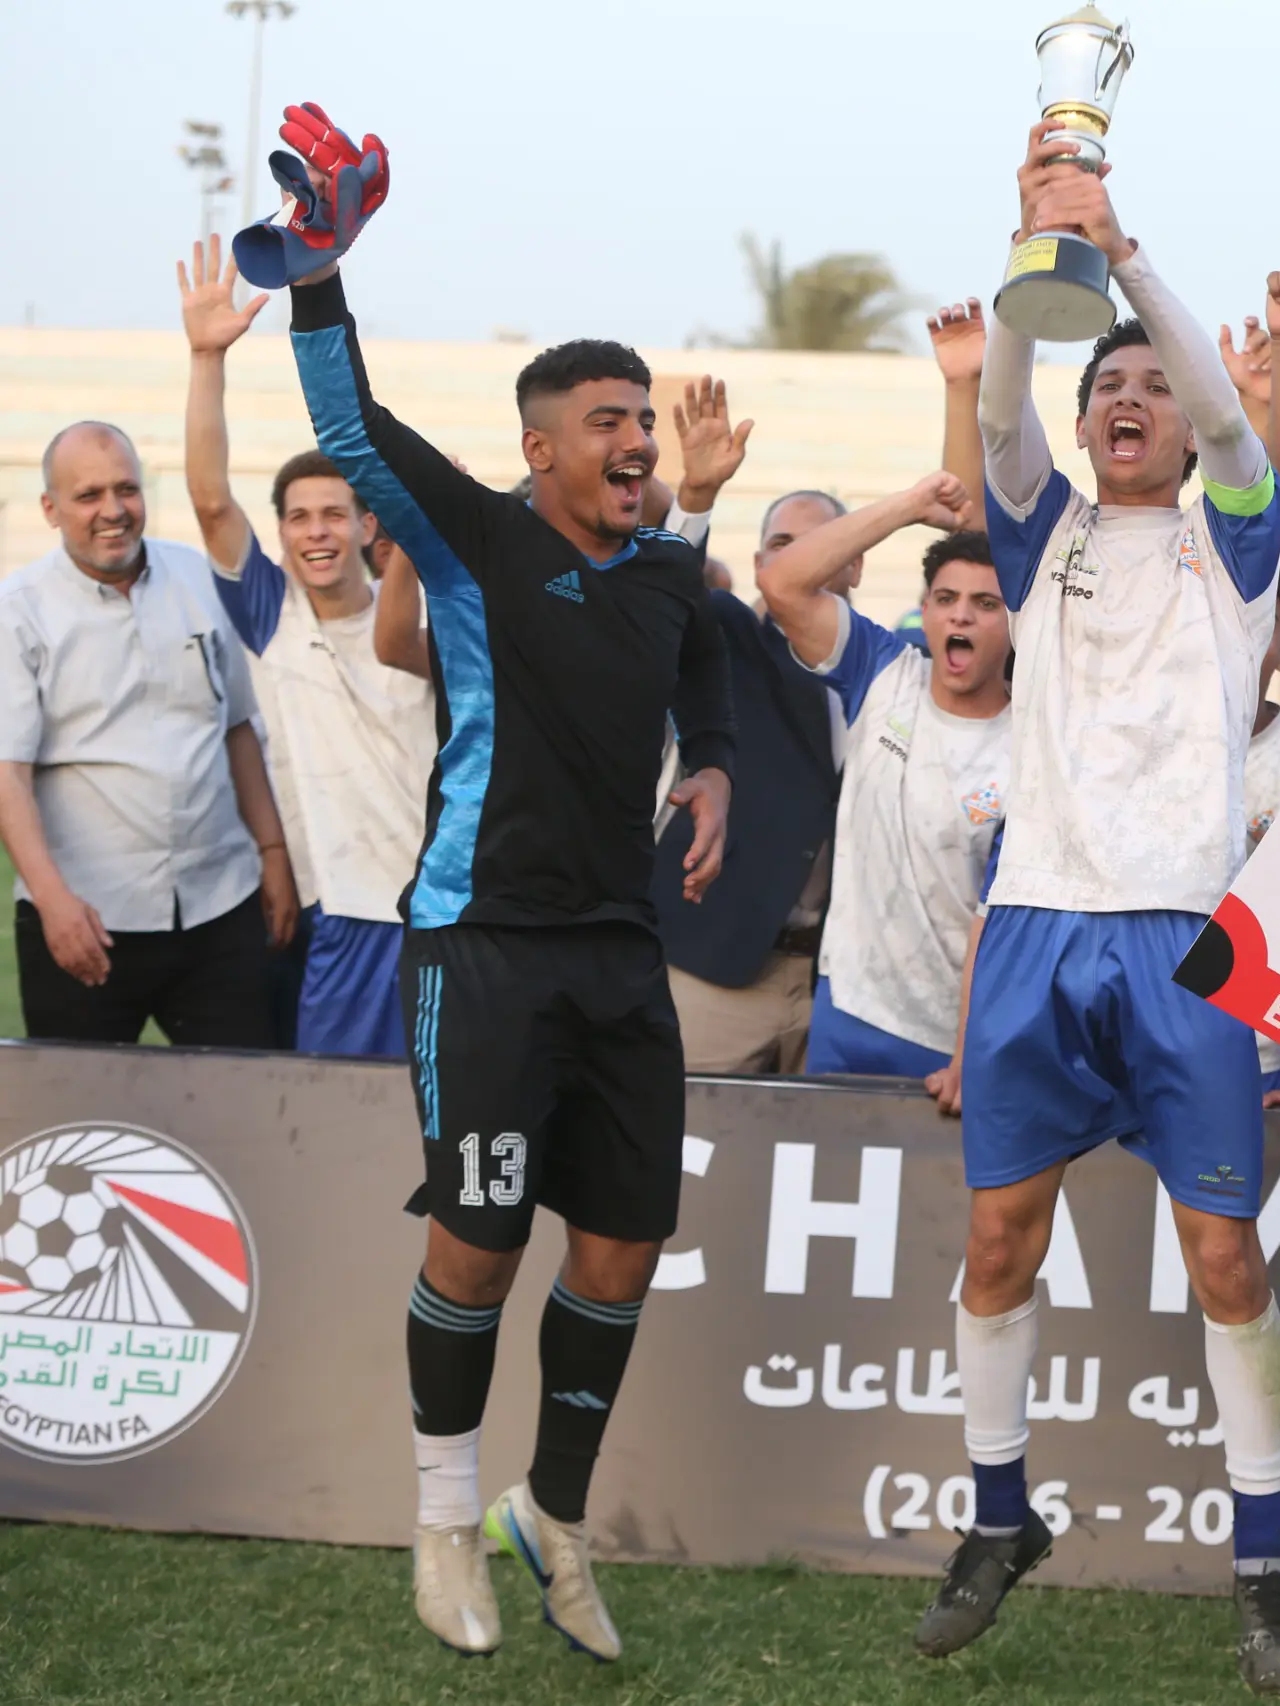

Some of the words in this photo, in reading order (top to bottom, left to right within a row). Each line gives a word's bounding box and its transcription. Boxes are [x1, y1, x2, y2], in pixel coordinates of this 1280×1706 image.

[459, 1132, 527, 1206] 13
[0, 1326, 93, 1360] المصر
[108, 1327, 209, 1363] الاتحاد
[92, 1365, 181, 1406] لكرة
[743, 1343, 1101, 1422] للطاعات
[118, 1414, 151, 1441] FA
[863, 1465, 1072, 1539] (206
